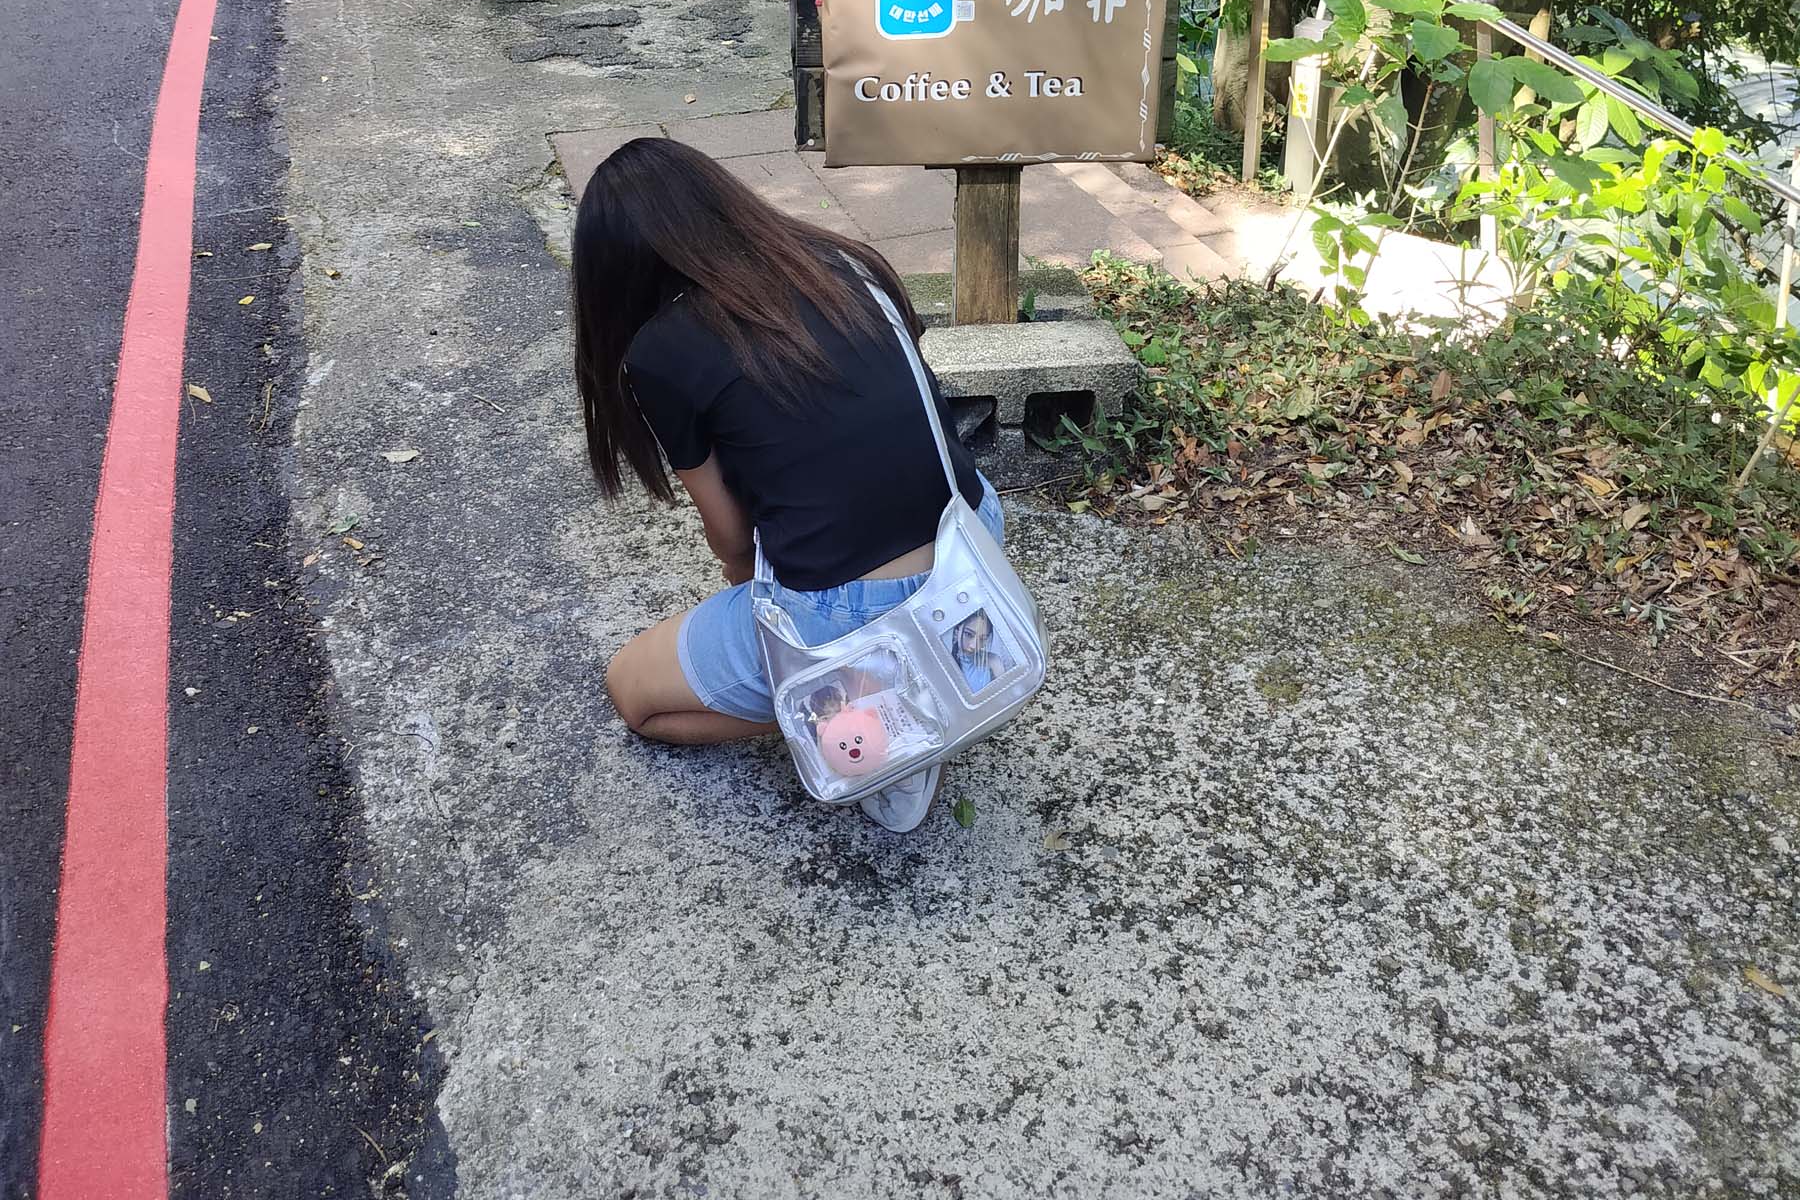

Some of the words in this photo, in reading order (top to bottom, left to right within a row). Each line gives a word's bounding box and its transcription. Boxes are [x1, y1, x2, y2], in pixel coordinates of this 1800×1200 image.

[854, 72, 972, 101] Coffee
[985, 71, 1014, 98] &
[1023, 70, 1085, 98] Tea
